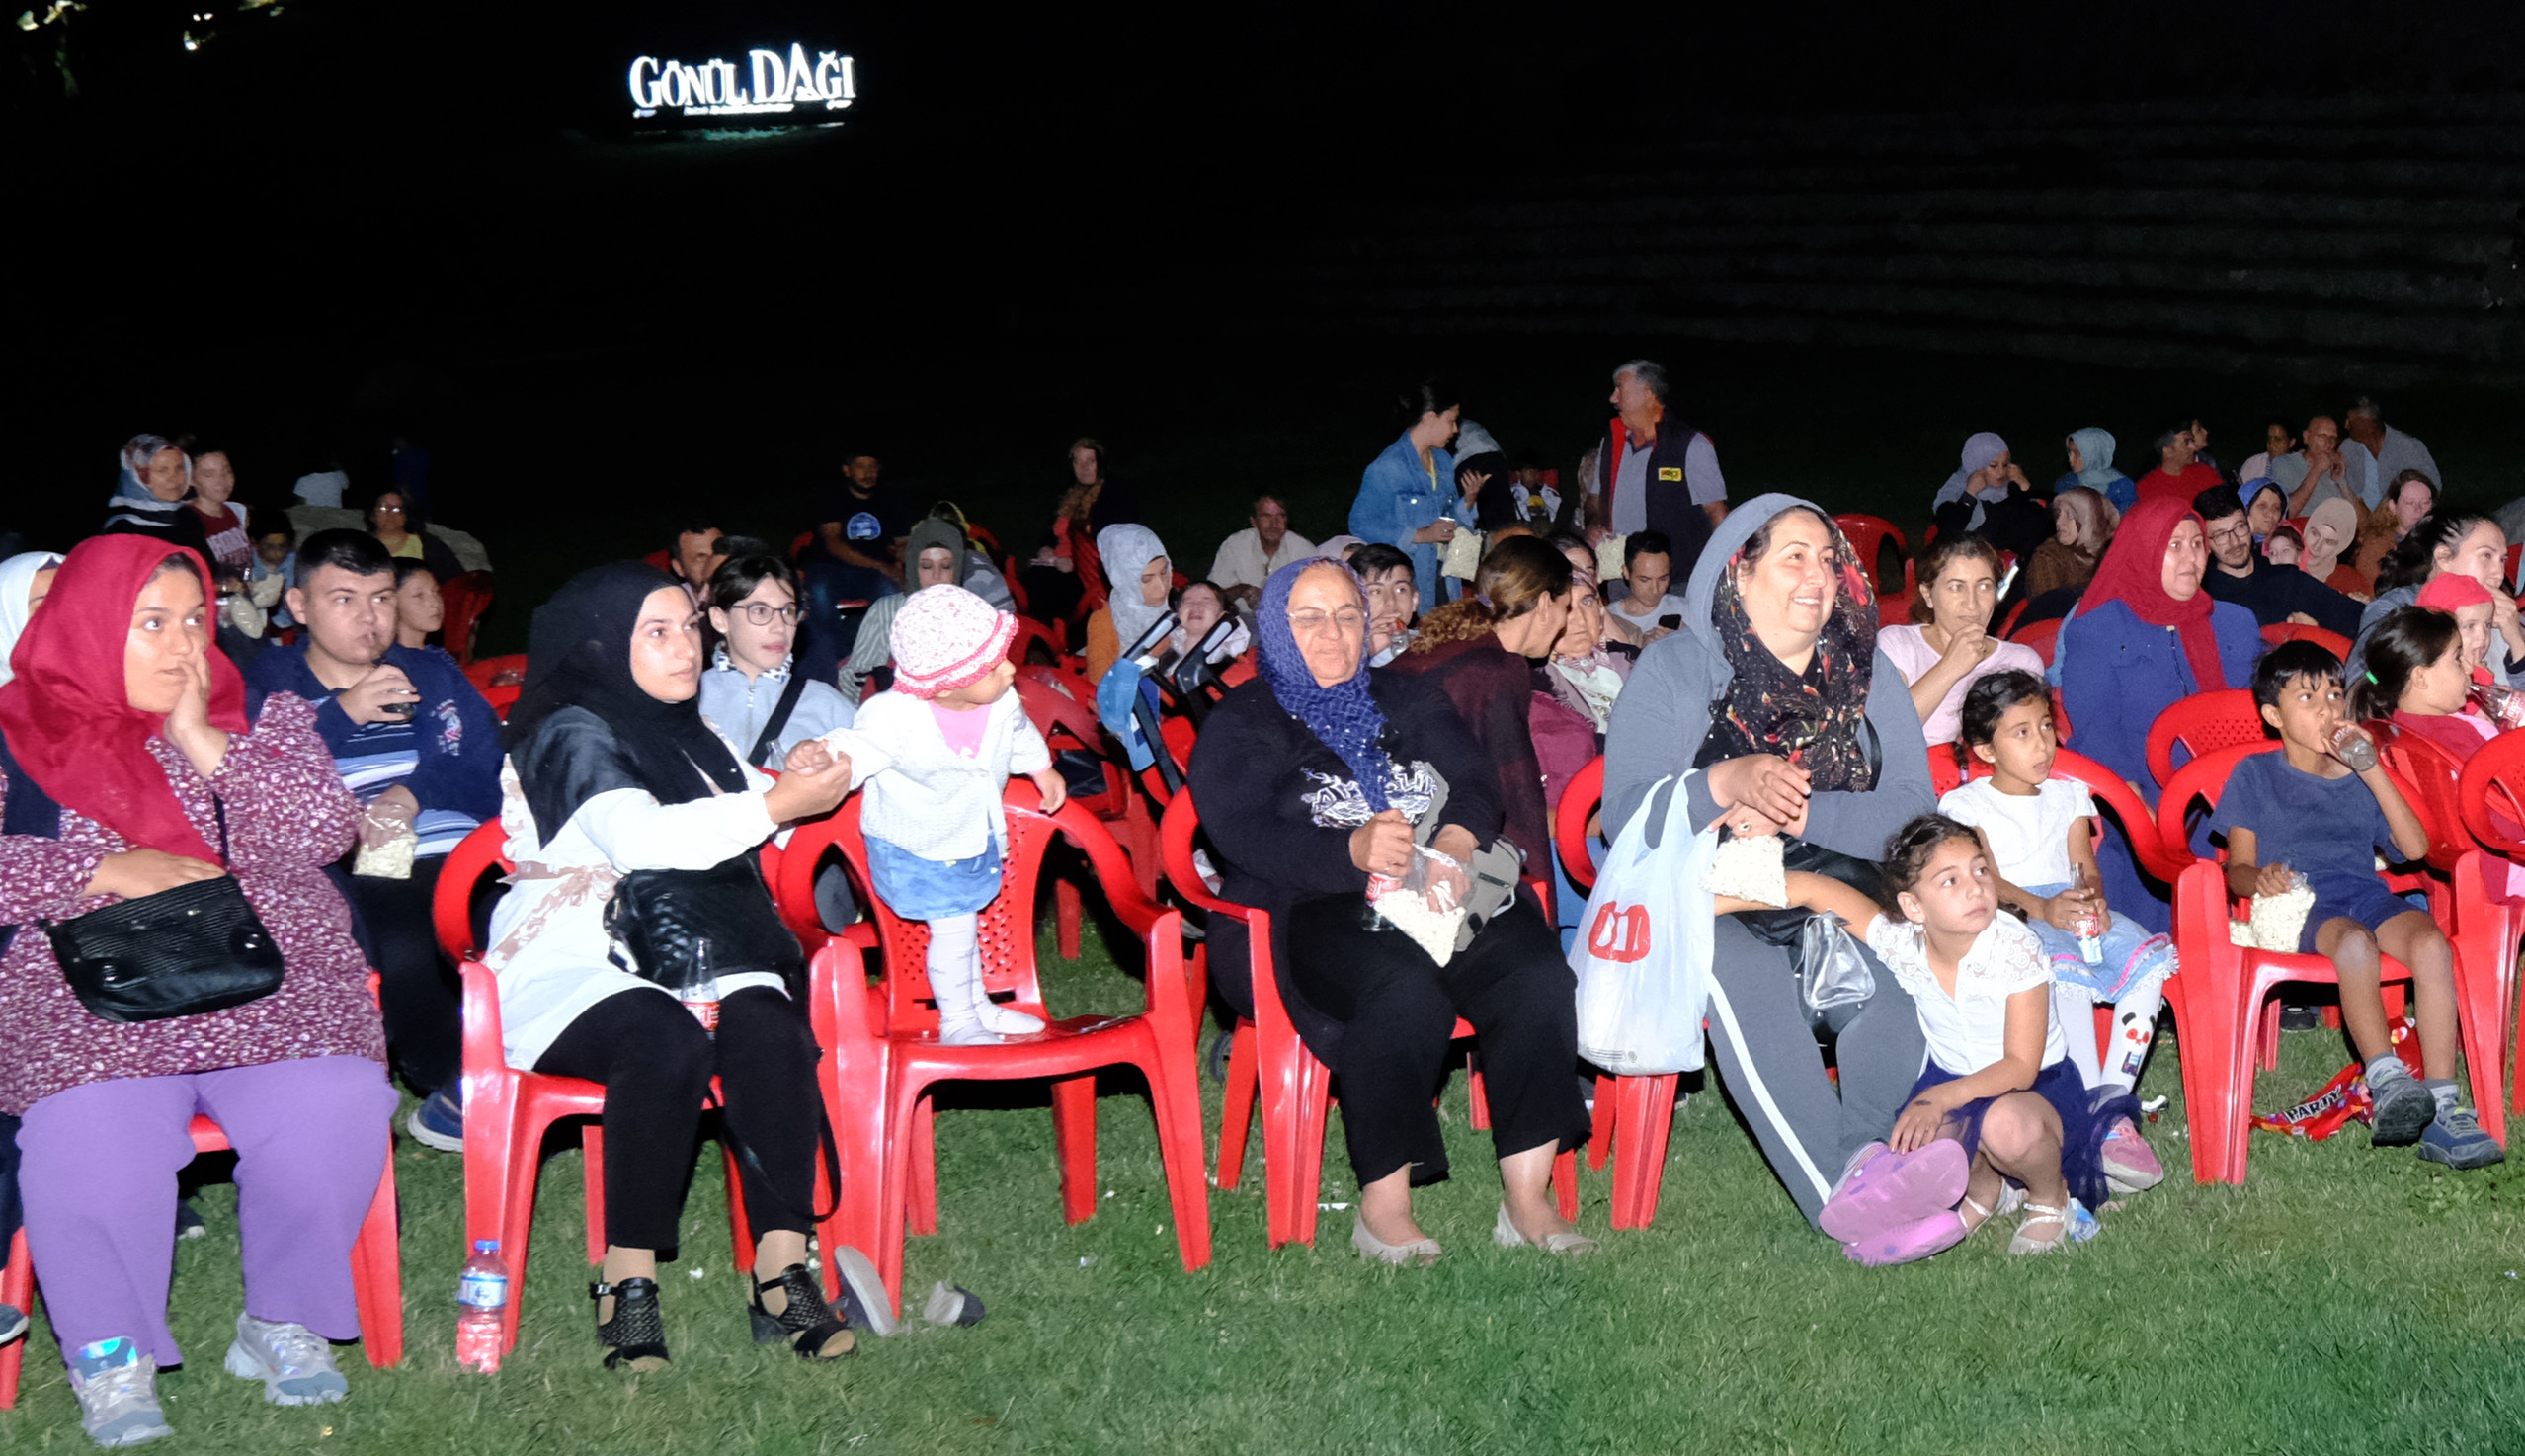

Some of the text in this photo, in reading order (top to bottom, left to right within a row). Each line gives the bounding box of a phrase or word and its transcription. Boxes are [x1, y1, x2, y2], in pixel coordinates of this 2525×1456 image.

[629, 42, 856, 108] GÖNÜL DAĞI
[2284, 1084, 2342, 1124] PARTY
